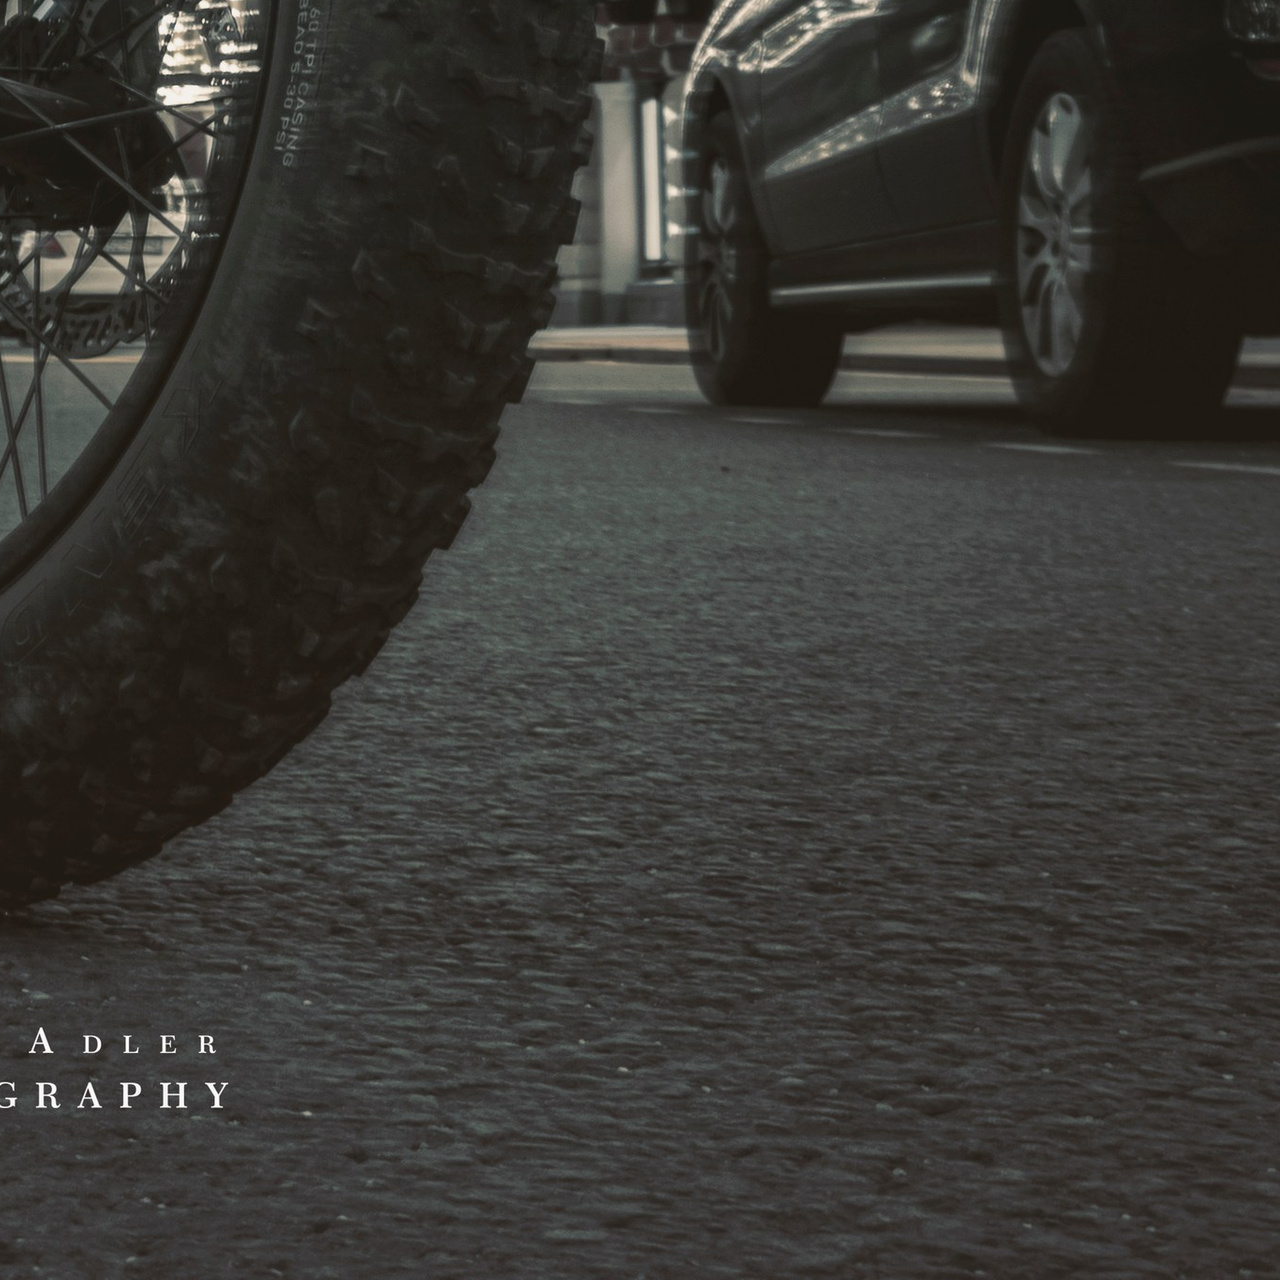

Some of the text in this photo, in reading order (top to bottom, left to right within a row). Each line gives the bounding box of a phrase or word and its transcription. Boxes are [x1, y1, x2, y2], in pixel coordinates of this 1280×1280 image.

[302, 38, 318, 74] TPI
[284, 61, 301, 109] 5-30
[274, 116, 290, 151] PSI
[282, 82, 309, 167] CASING
